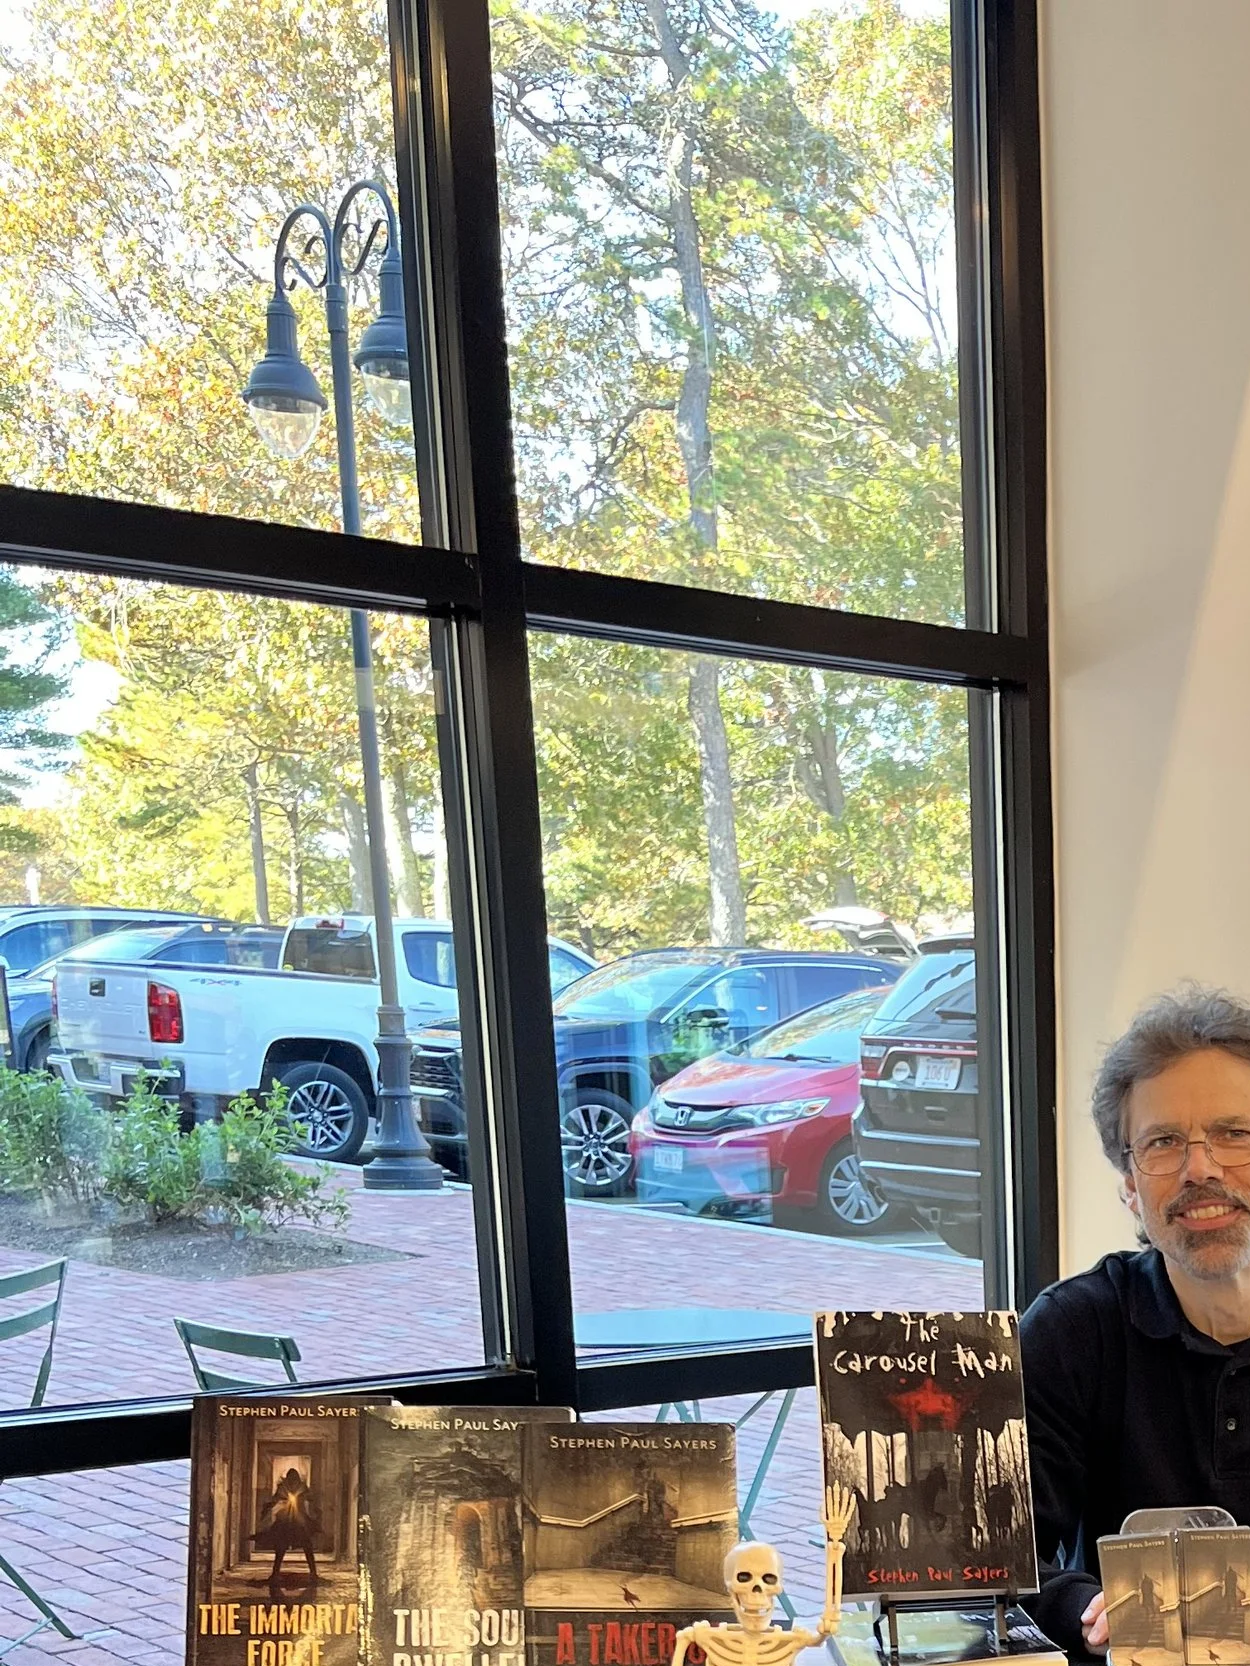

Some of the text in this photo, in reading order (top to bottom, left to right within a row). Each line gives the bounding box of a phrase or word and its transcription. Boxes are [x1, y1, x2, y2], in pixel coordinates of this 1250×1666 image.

[833, 1343, 1012, 1378] Carousel Man
[219, 1405, 359, 1417] STEPHEN PAUL SAYER
[391, 1419, 519, 1431] STEPHEN PAUL SAY
[550, 1436, 717, 1450] STEPHEN PAUL SAYERS
[868, 1566, 1008, 1584] Stephen Paul Sayers
[199, 1604, 358, 1635] THE IMMORTA
[393, 1608, 449, 1647] THE
[556, 1622, 576, 1665] A
[588, 1621, 676, 1665] TAKER
